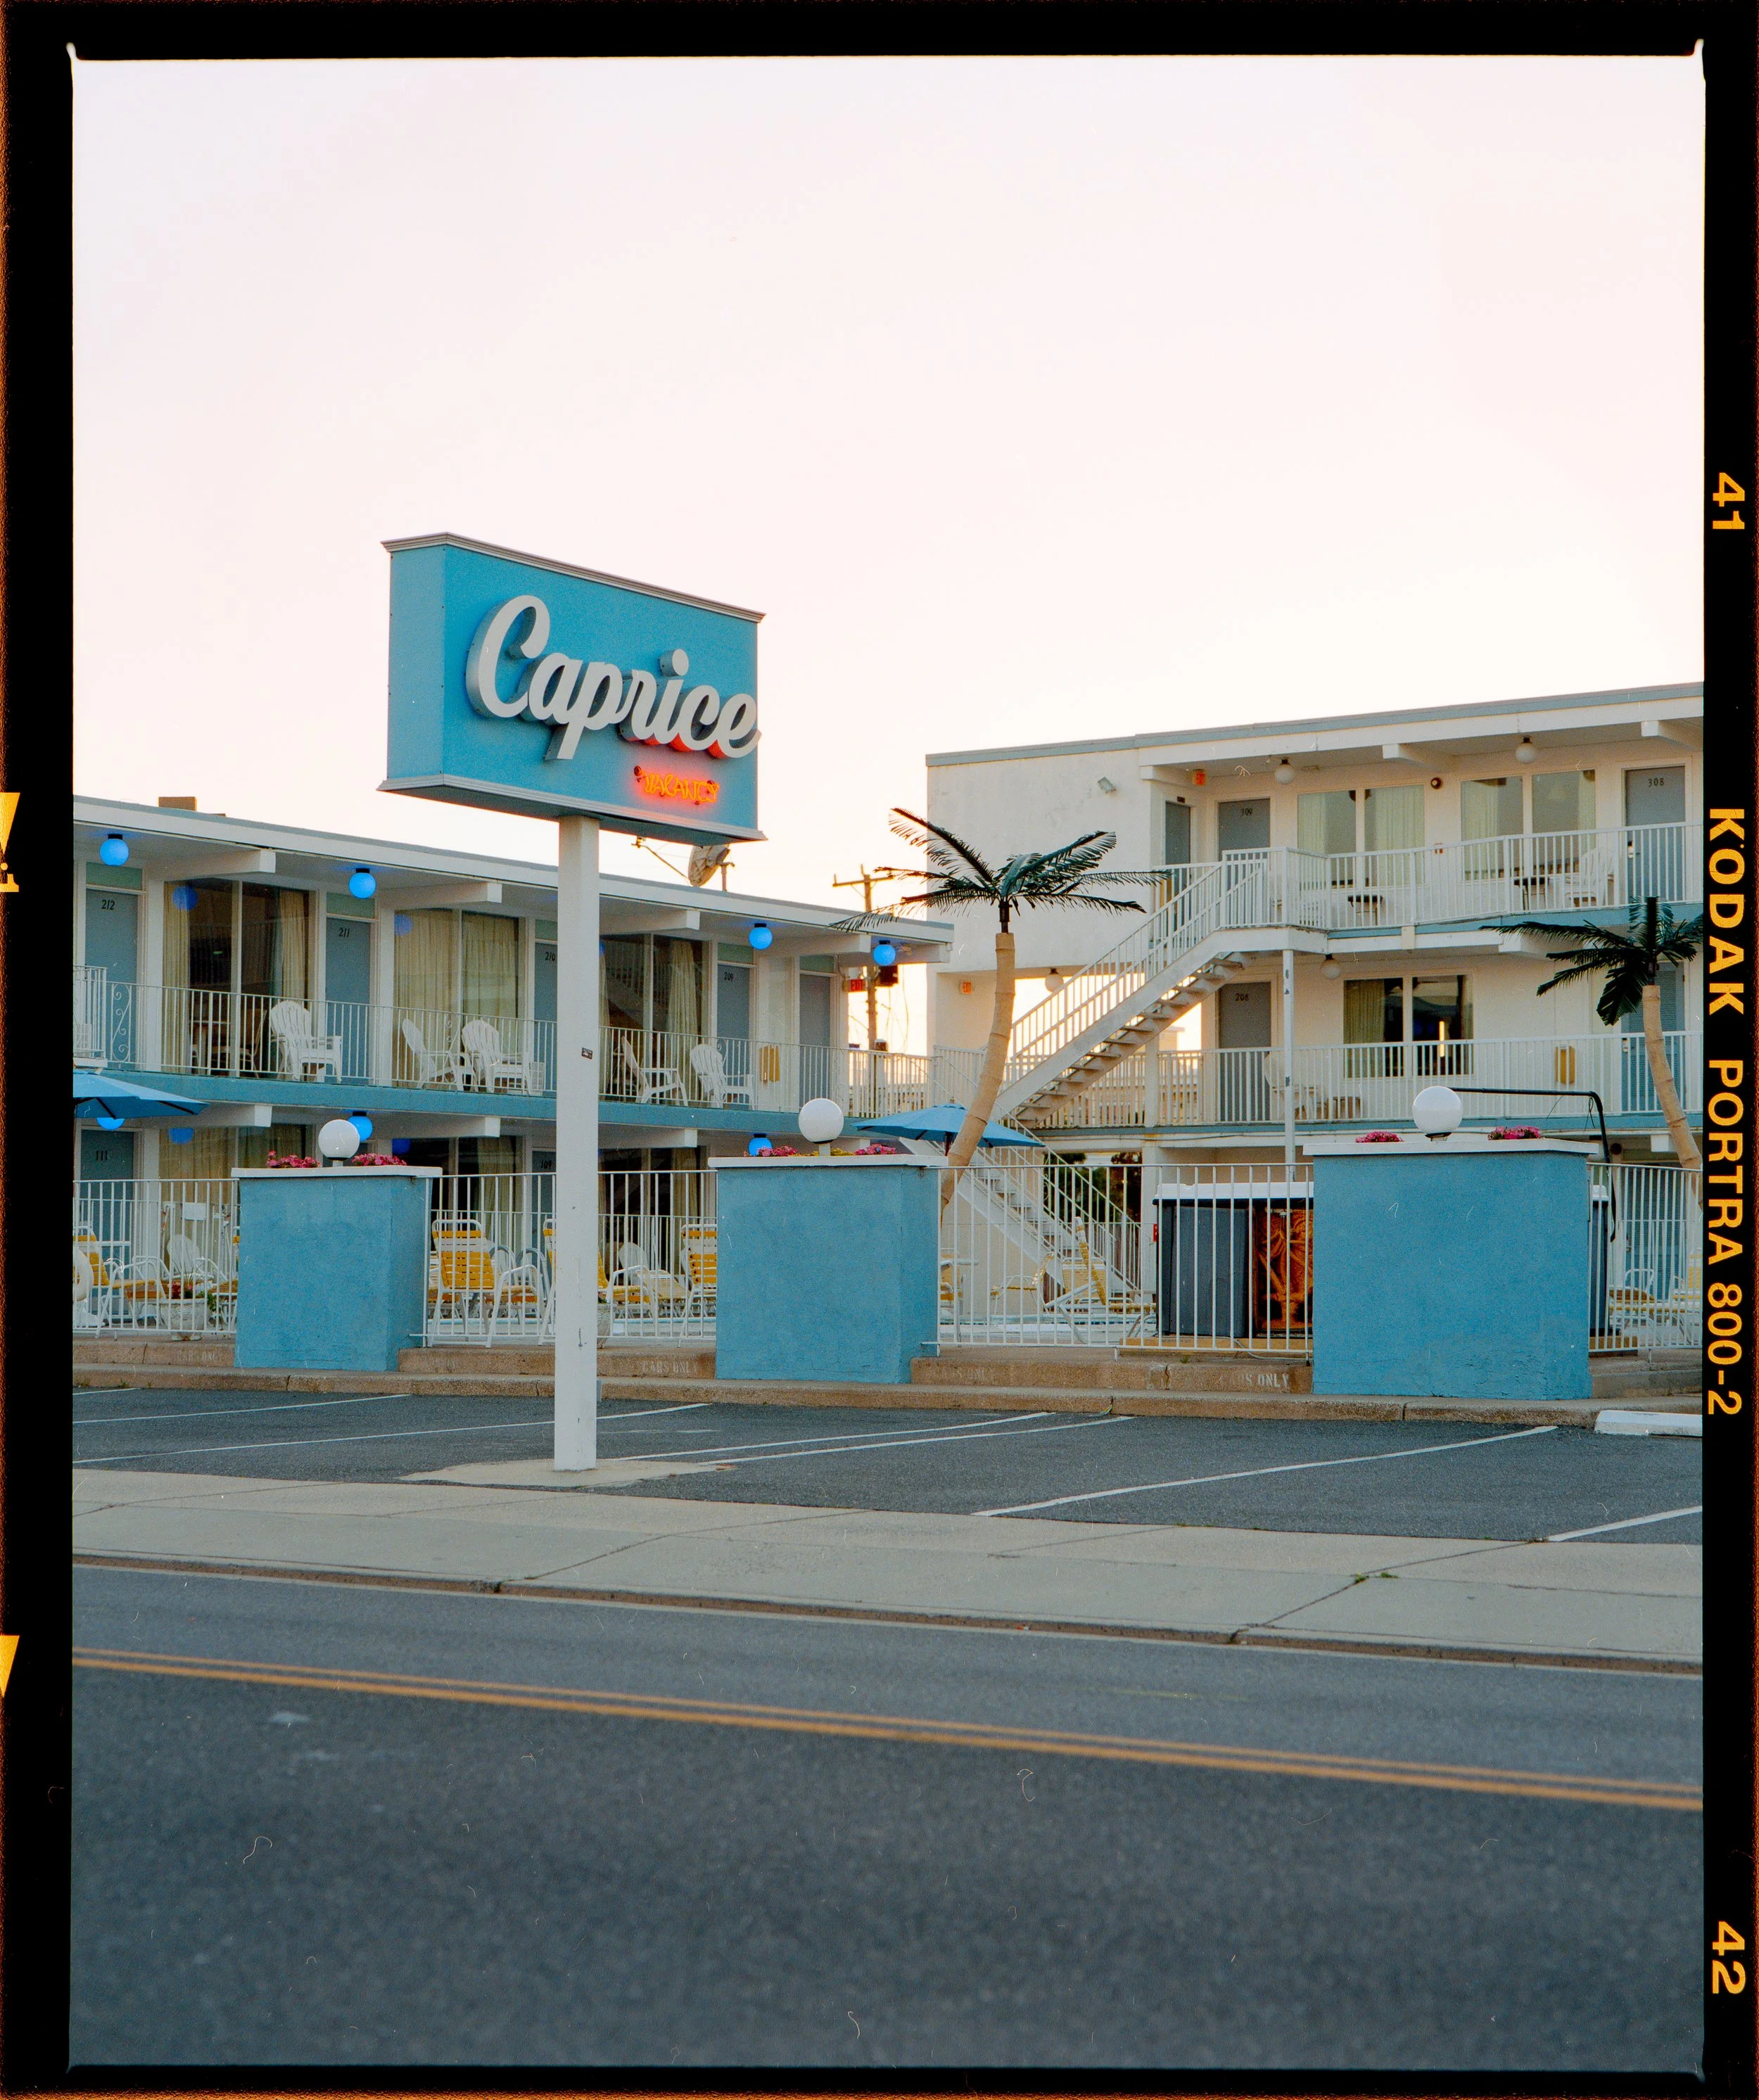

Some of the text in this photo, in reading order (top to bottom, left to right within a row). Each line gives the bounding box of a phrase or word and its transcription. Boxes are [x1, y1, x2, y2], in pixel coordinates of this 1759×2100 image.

[1713, 473, 1745, 529] 41
[466, 594, 761, 759] Caprice
[643, 772, 719, 802] VACANCY
[1648, 777, 1664, 787] 308
[101, 899, 115, 910] 212
[338, 927, 350, 938] 211
[545, 952, 555, 961] 210
[1708, 808, 1745, 1414] KODAK PORTRA 800-2
[96, 1150, 108, 1161] 111
[1257, 1373, 1290, 1387] ONLY
[1713, 1922, 1746, 1994] 42
